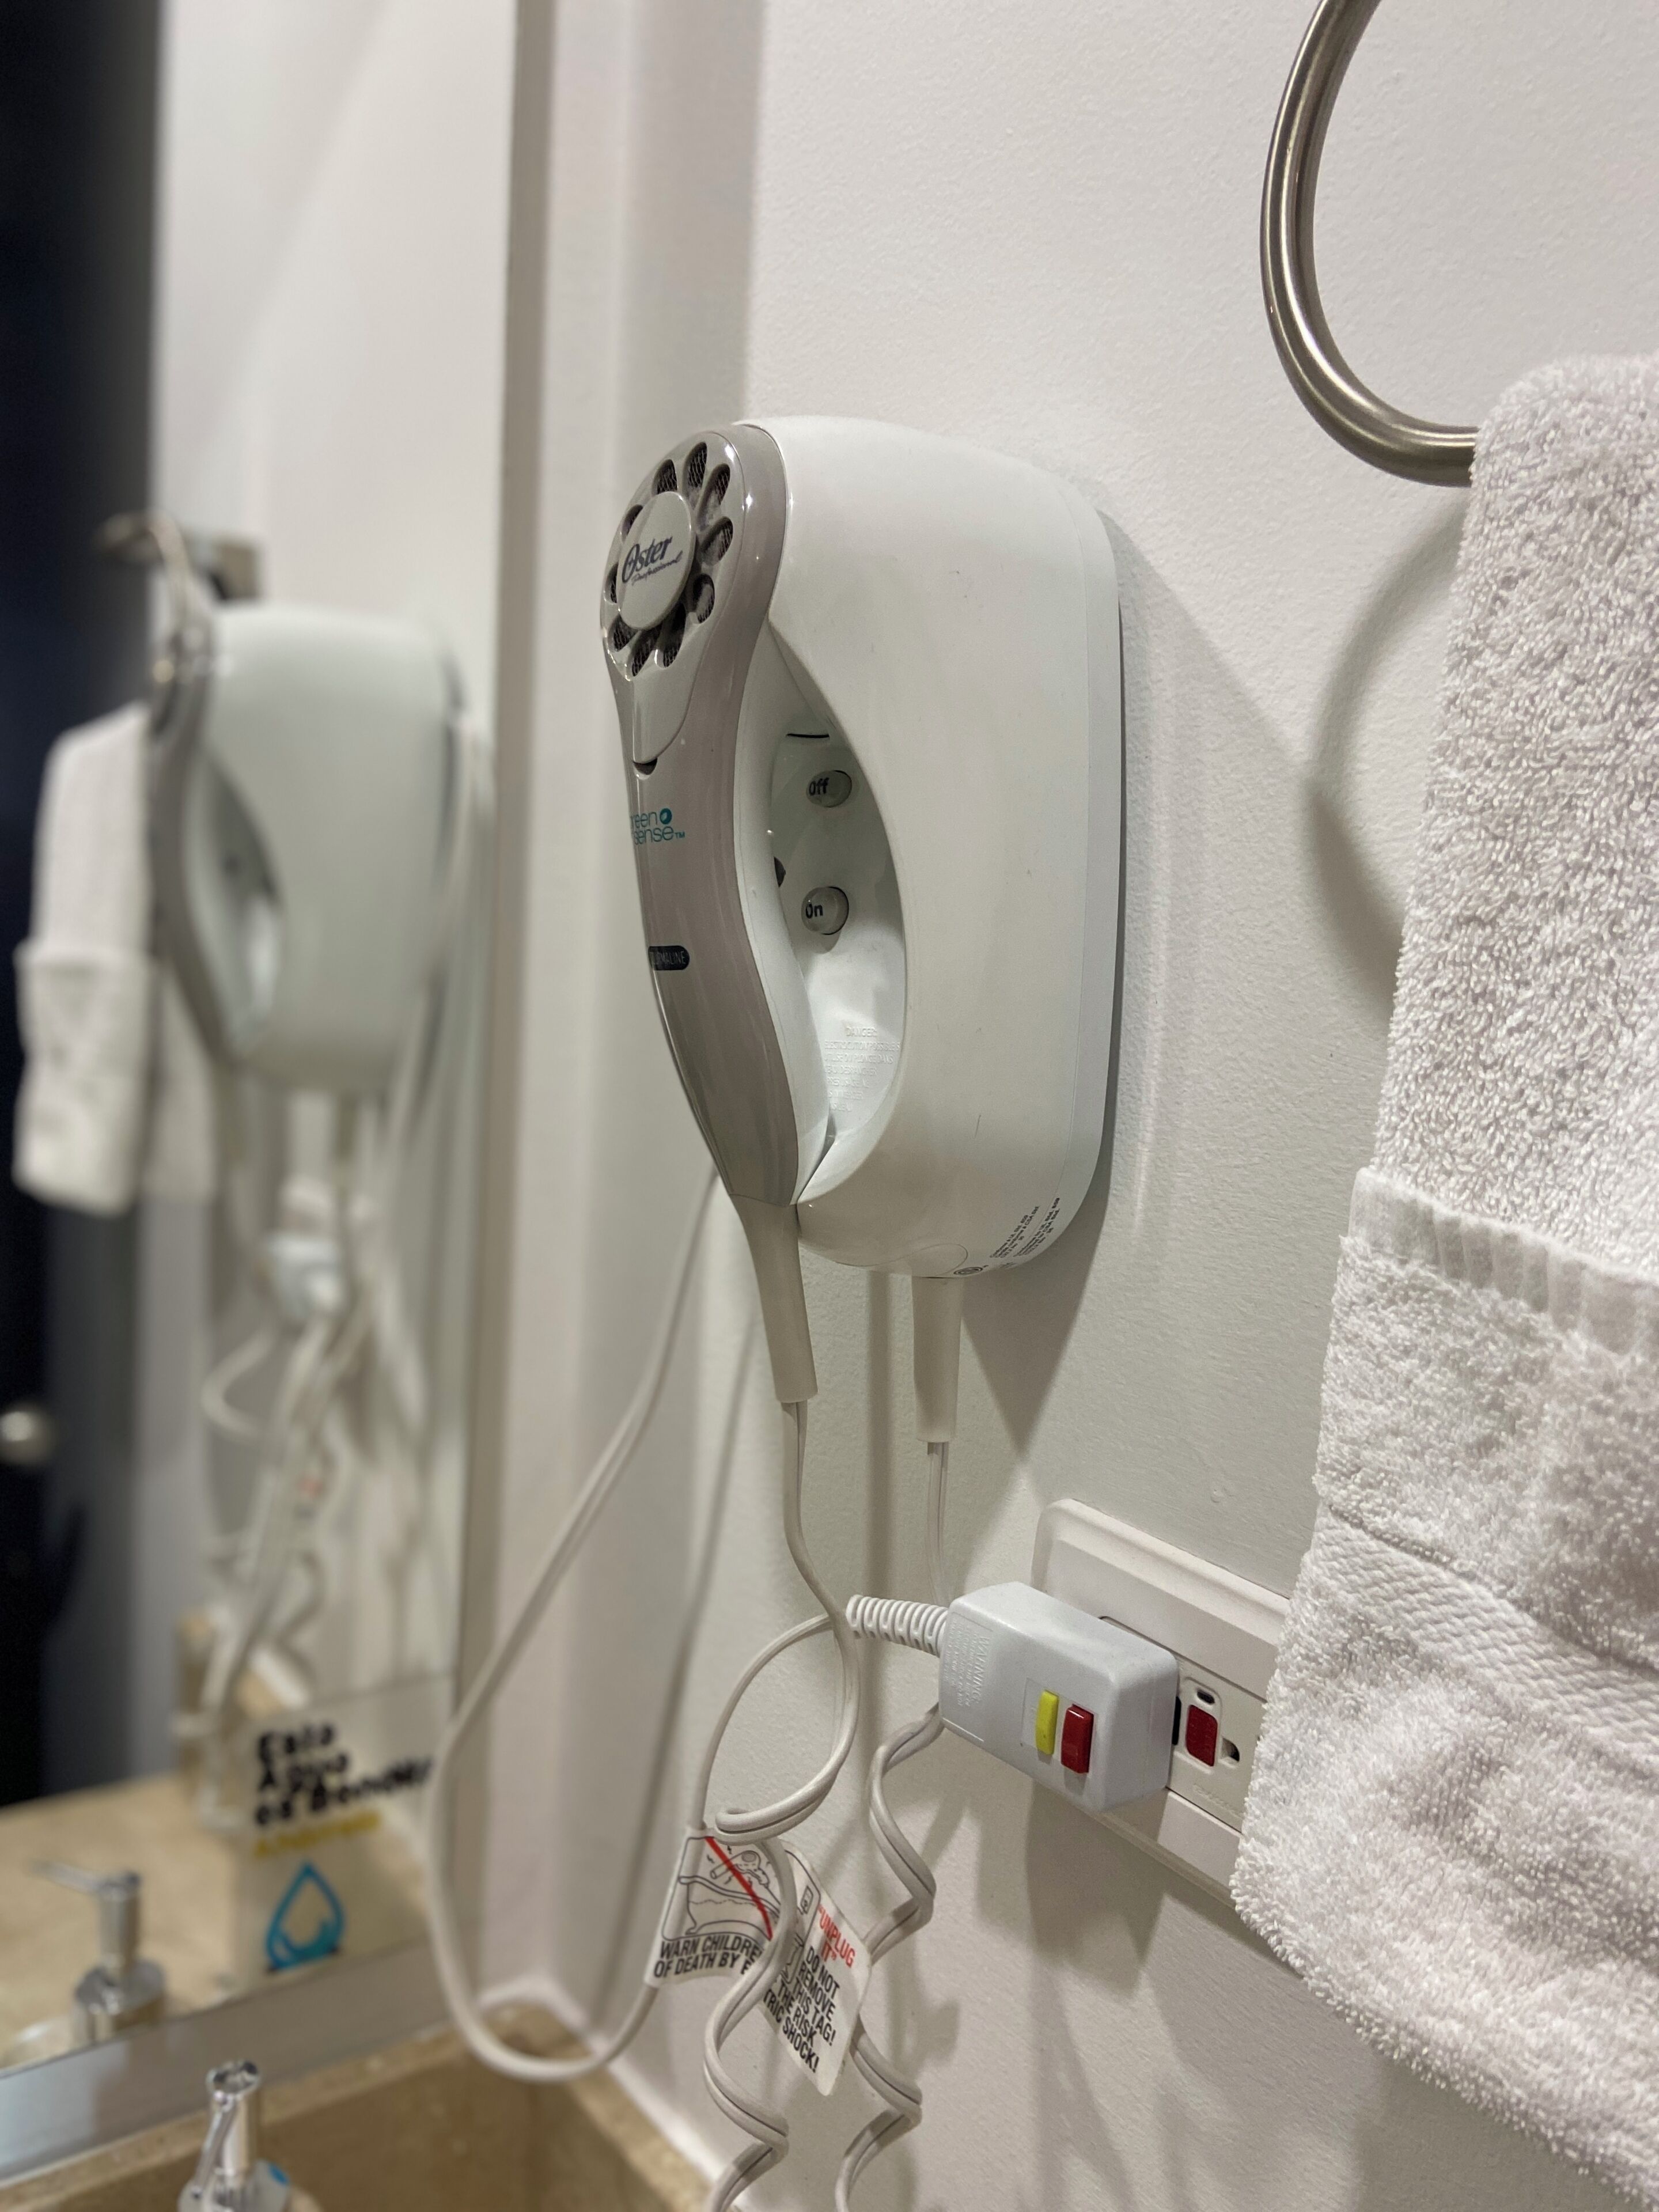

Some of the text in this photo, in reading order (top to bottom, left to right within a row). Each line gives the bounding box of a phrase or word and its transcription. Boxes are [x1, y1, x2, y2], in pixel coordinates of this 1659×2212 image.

[622, 536, 673, 583] Oster
[808, 777, 829, 796] Off
[631, 811, 657, 828] reen
[805, 903, 824, 919] On
[654, 1960, 673, 1978] OF
[674, 1953, 716, 1975] DEATH
[718, 1952, 740, 1968] BY
[660, 1938, 700, 1959] WARN
[798, 1960, 835, 2021] REMOVE
[807, 1946, 840, 1999] DO NOT
[778, 1978, 816, 2047] THE RISK
[793, 1977, 835, 2046] THIS TAG!
[782, 2016, 819, 2073] SHOCK!
